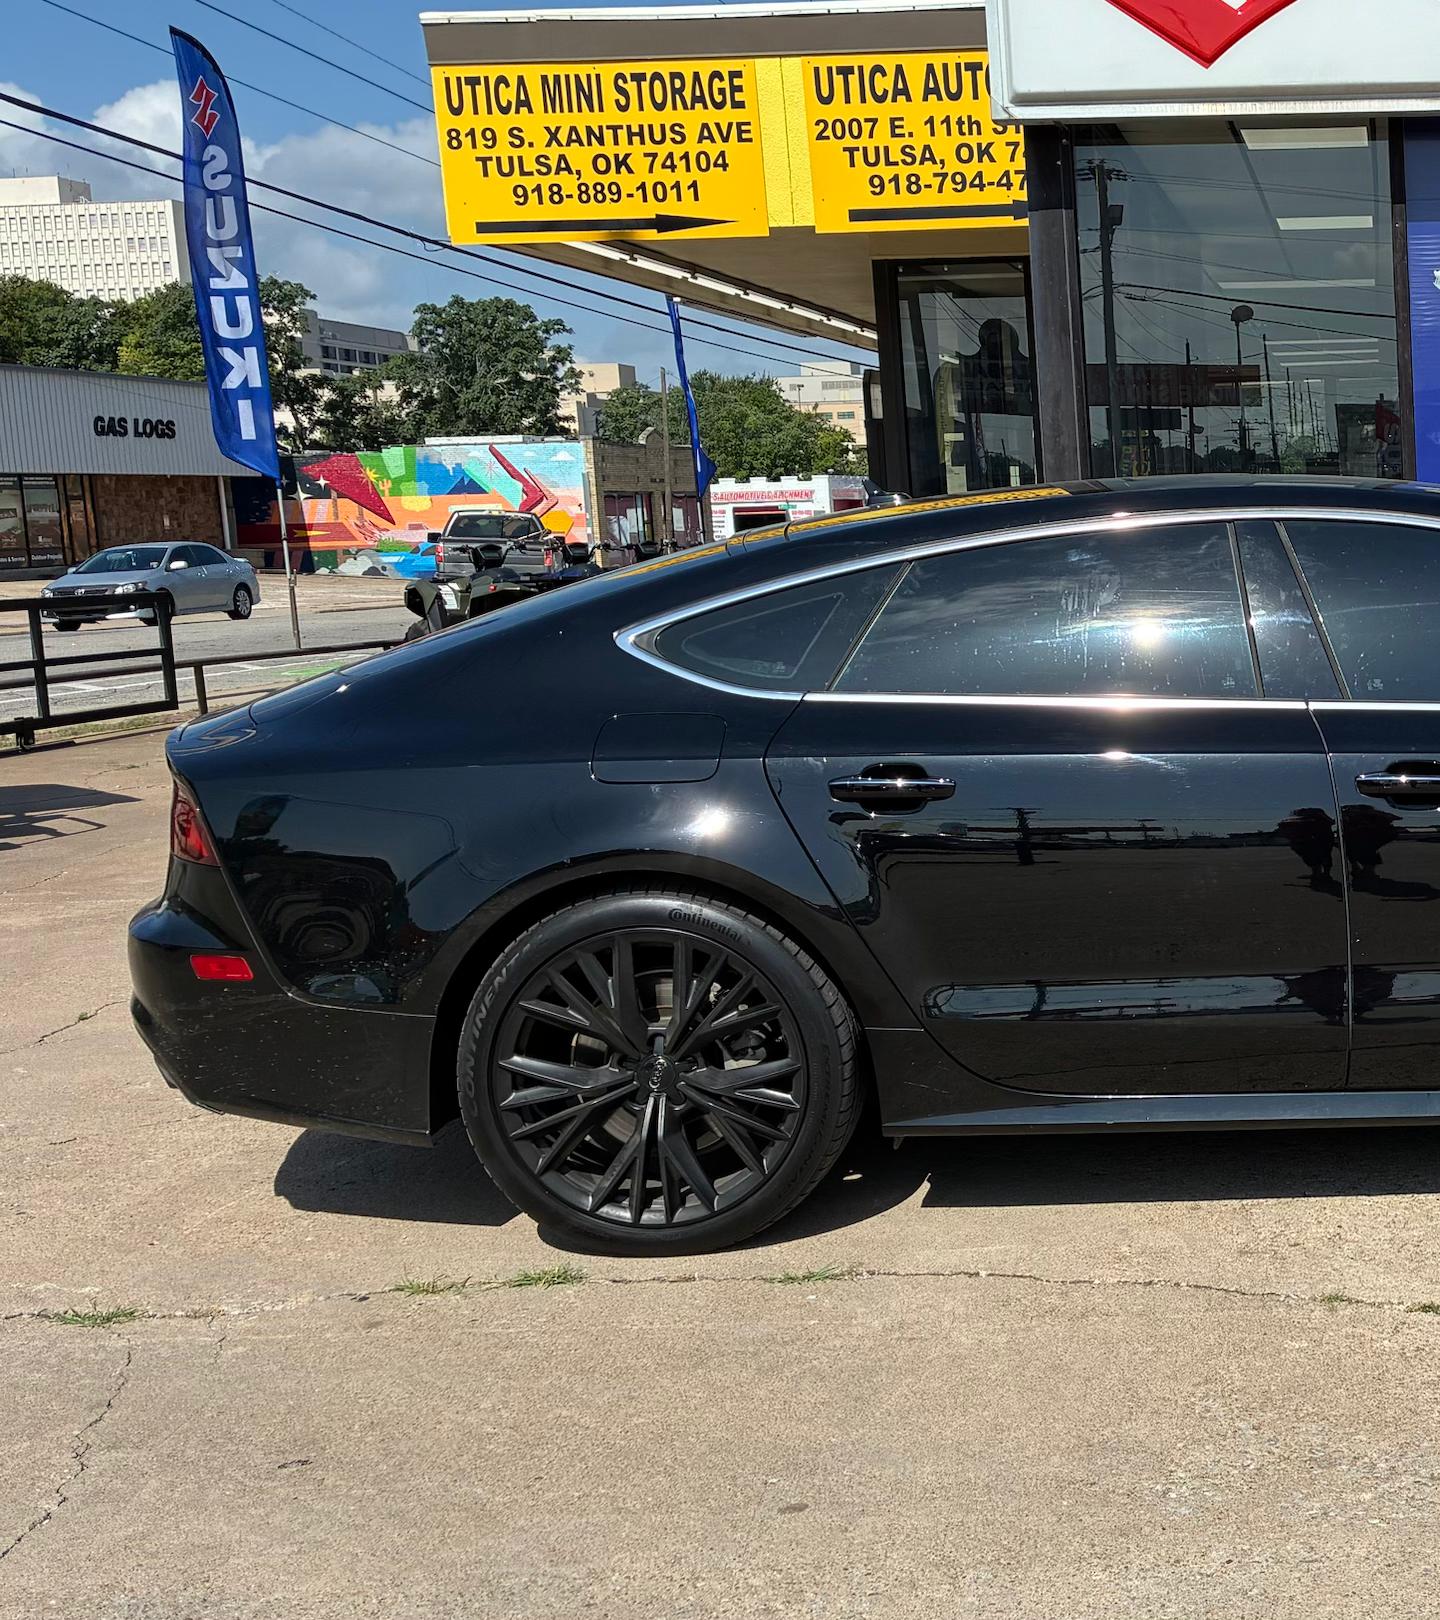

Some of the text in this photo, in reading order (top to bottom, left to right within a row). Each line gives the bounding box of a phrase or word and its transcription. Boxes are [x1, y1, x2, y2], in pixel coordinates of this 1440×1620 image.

[444, 70, 746, 116] UTICA MINI STORAGE
[813, 62, 991, 105] UTICA AUT
[446, 121, 753, 150] 819 S. XANTHUS AVE
[814, 117, 879, 141] 2007
[890, 116, 914, 138] E.
[924, 114, 982, 137] 11th
[475, 150, 729, 180] TULSA, OK 74104
[842, 144, 946, 169] TULSA,
[955, 142, 997, 164] OK
[512, 180, 700, 206] 918-889-1011
[93, 415, 176, 439] GAS LOGS
[668, 908, 742, 942] Continental
